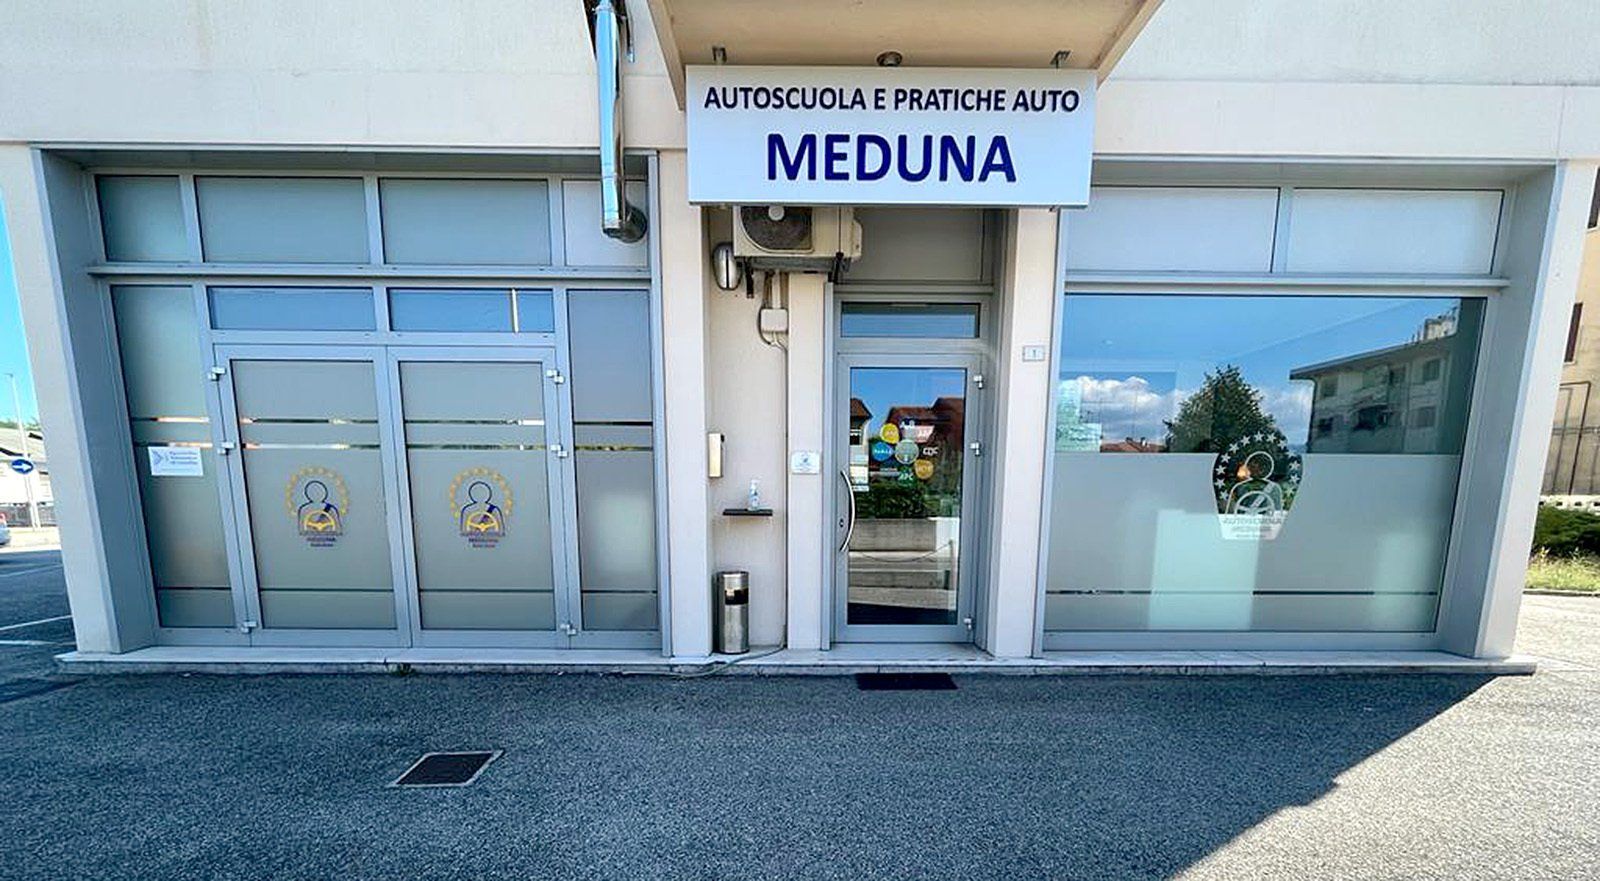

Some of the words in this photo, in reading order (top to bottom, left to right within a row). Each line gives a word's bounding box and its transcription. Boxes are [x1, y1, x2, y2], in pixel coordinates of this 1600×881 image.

[704, 87, 866, 111] AUTOSCUOLA
[875, 88, 886, 110] E
[894, 88, 1006, 111] PRATICHE
[1012, 89, 1080, 112] AUTO
[767, 133, 1017, 183] MEDUNA
